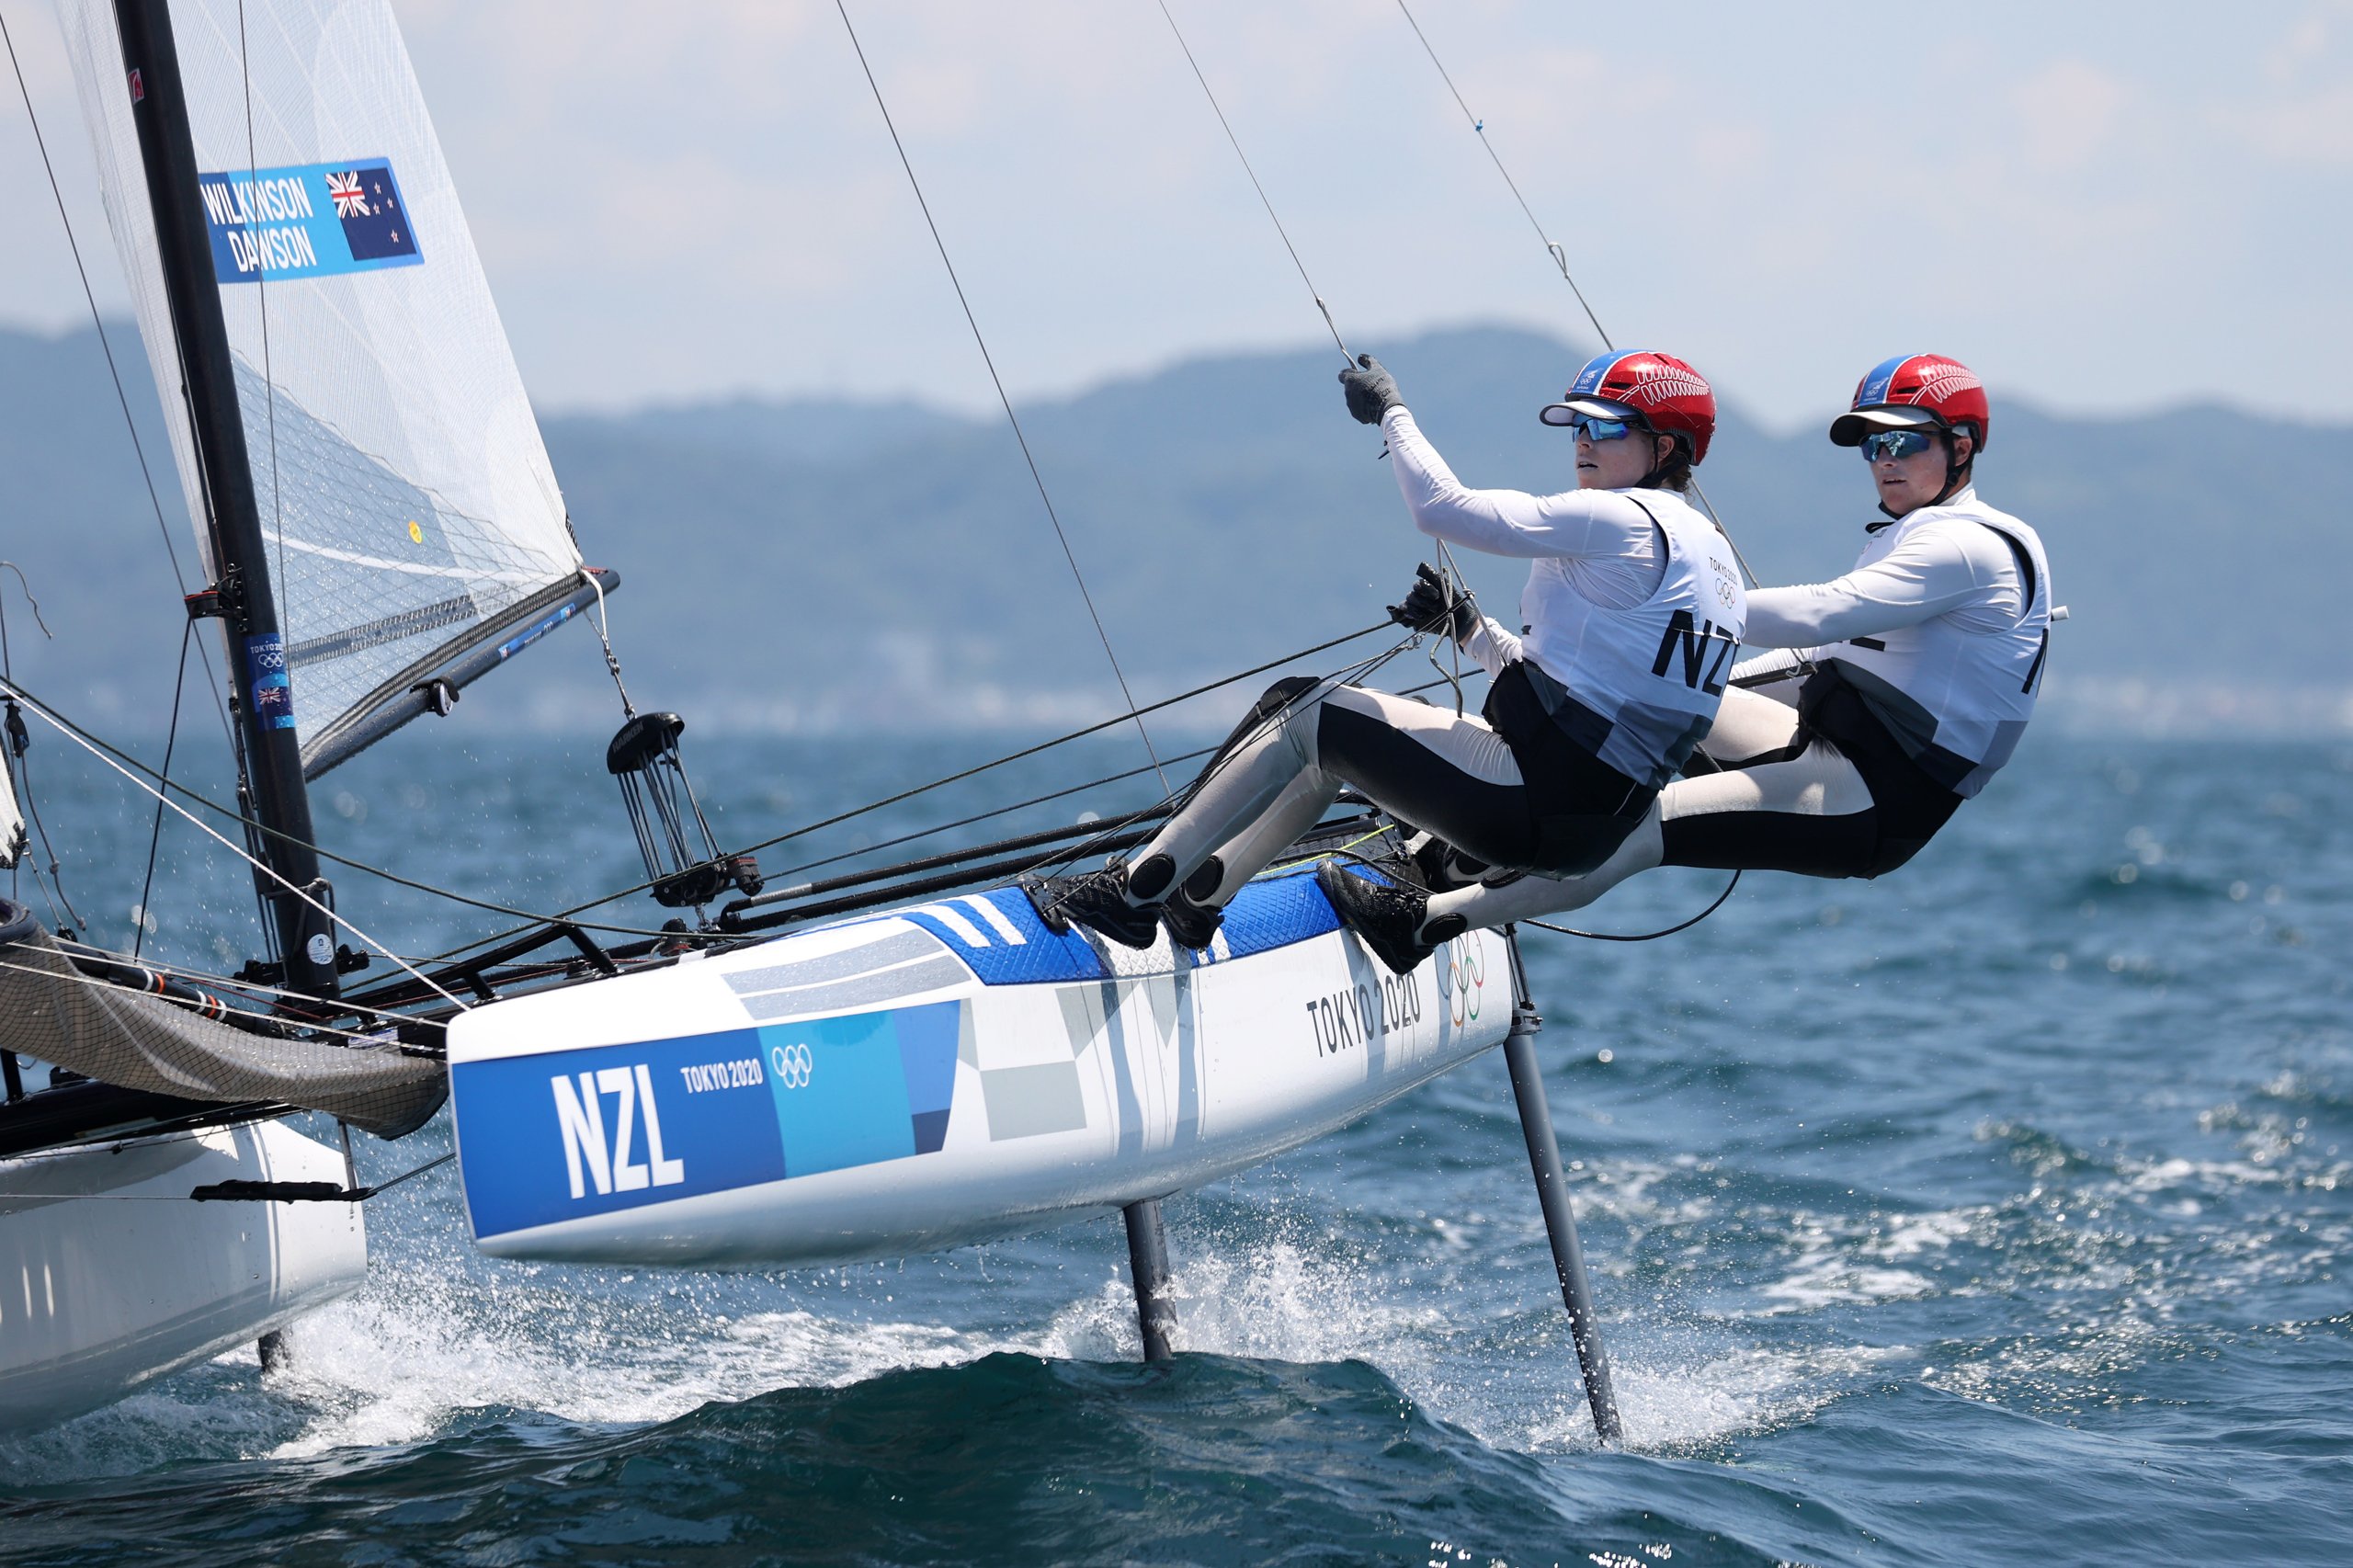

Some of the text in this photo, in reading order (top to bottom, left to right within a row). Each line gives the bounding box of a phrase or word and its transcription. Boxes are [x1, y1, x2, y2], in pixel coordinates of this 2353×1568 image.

[199, 176, 313, 225] WILKINSON
[227, 225, 317, 272] DAWSON
[1710, 557, 1728, 577] TOKYO
[250, 643, 275, 654] TOKYO
[1652, 609, 1740, 698] NZ
[612, 721, 644, 753] HARKEN
[1306, 971, 1421, 1057] TOKYO 2020
[551, 1058, 764, 1199] NZL TOKYO 2020
